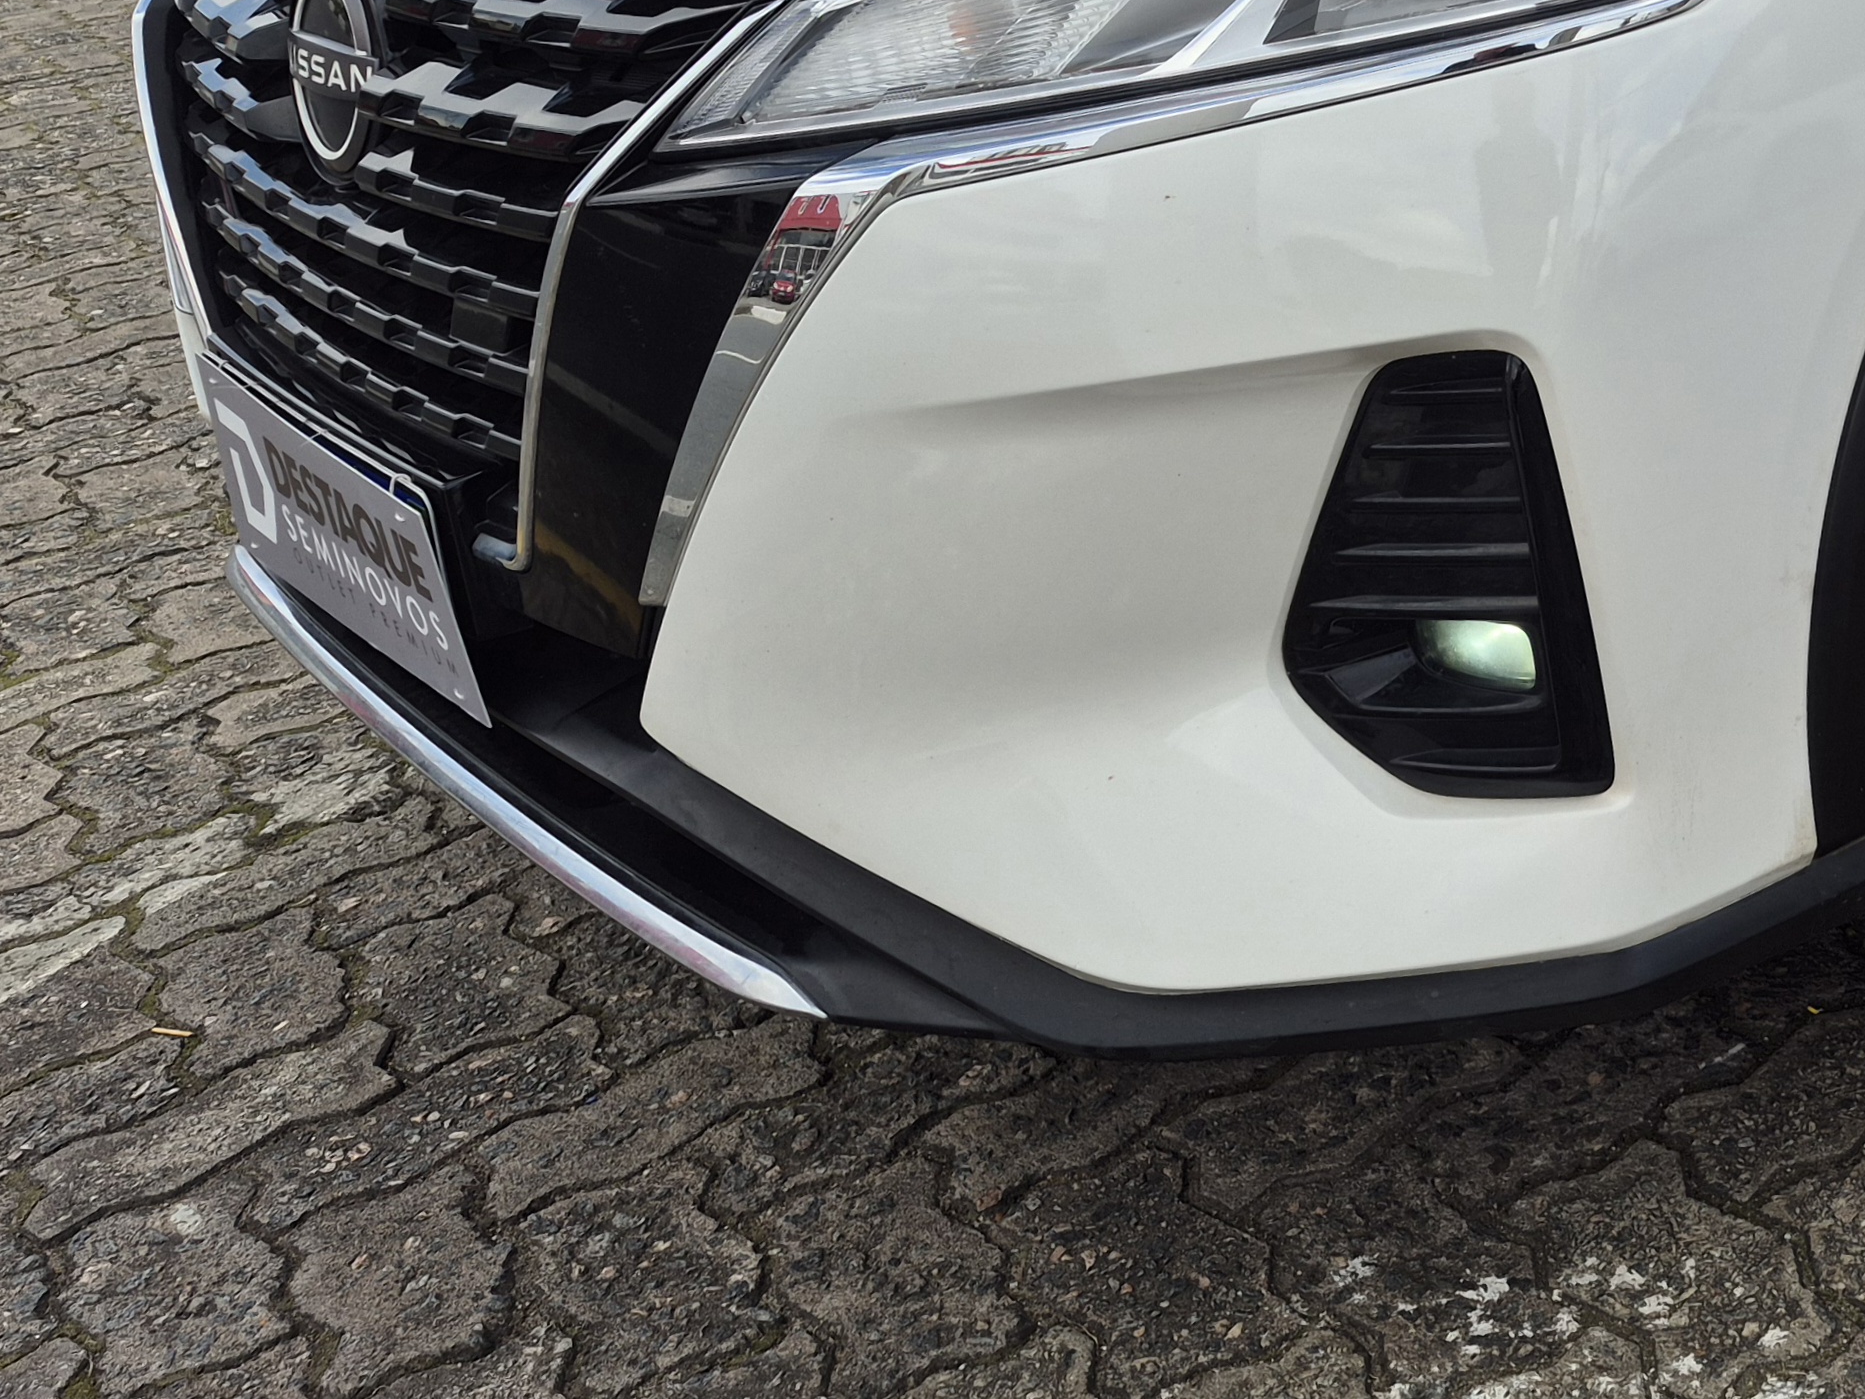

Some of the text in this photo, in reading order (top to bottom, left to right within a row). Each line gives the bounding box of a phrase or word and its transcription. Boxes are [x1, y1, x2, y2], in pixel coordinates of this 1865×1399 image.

[262, 435, 433, 603] DESTAQUE
[282, 504, 449, 651] SEMINOVOS
[293, 546, 357, 605] OUTLET
